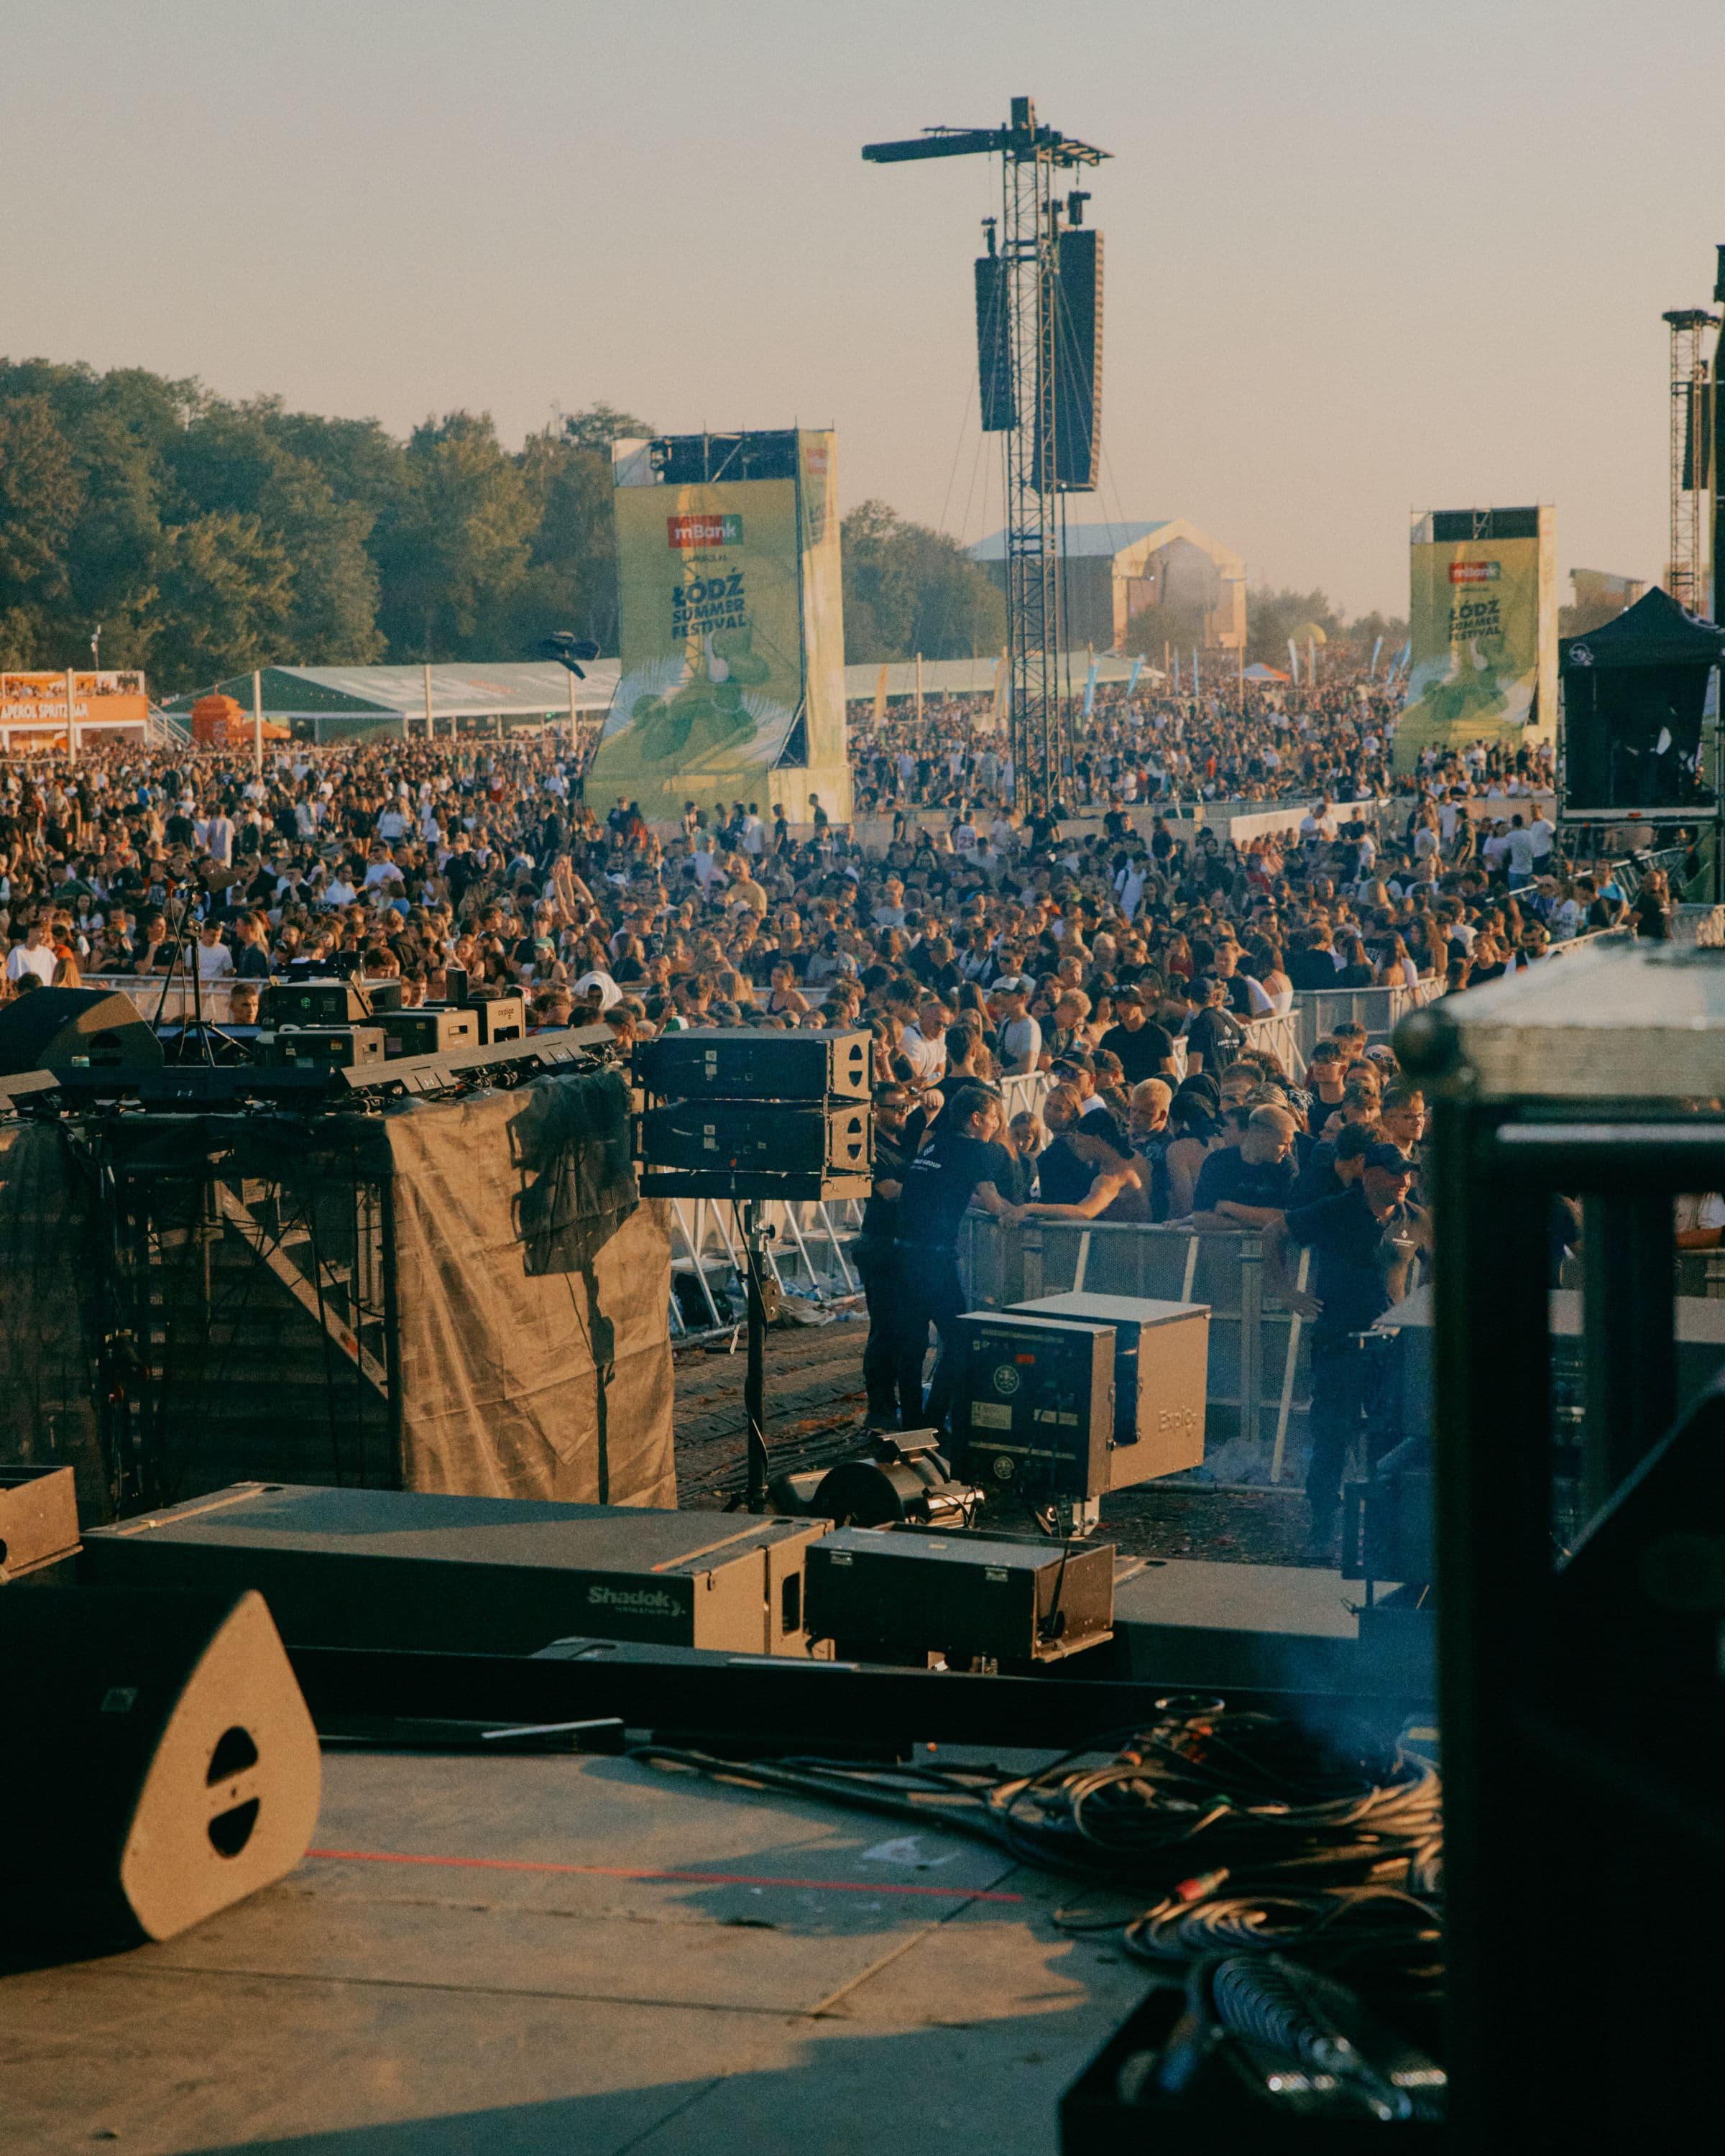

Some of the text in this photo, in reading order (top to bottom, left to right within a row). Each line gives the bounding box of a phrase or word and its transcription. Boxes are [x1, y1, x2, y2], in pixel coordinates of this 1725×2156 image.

[674, 522, 737, 540] mBank
[671, 566, 745, 608] ŁÓDŹ
[672, 597, 745, 623] SUMMER
[672, 613, 748, 640] FESTIVAL
[1, 704, 37, 719] APEROL
[39, 703, 69, 718] SPRITZ
[587, 1586, 670, 1607] Shadok
